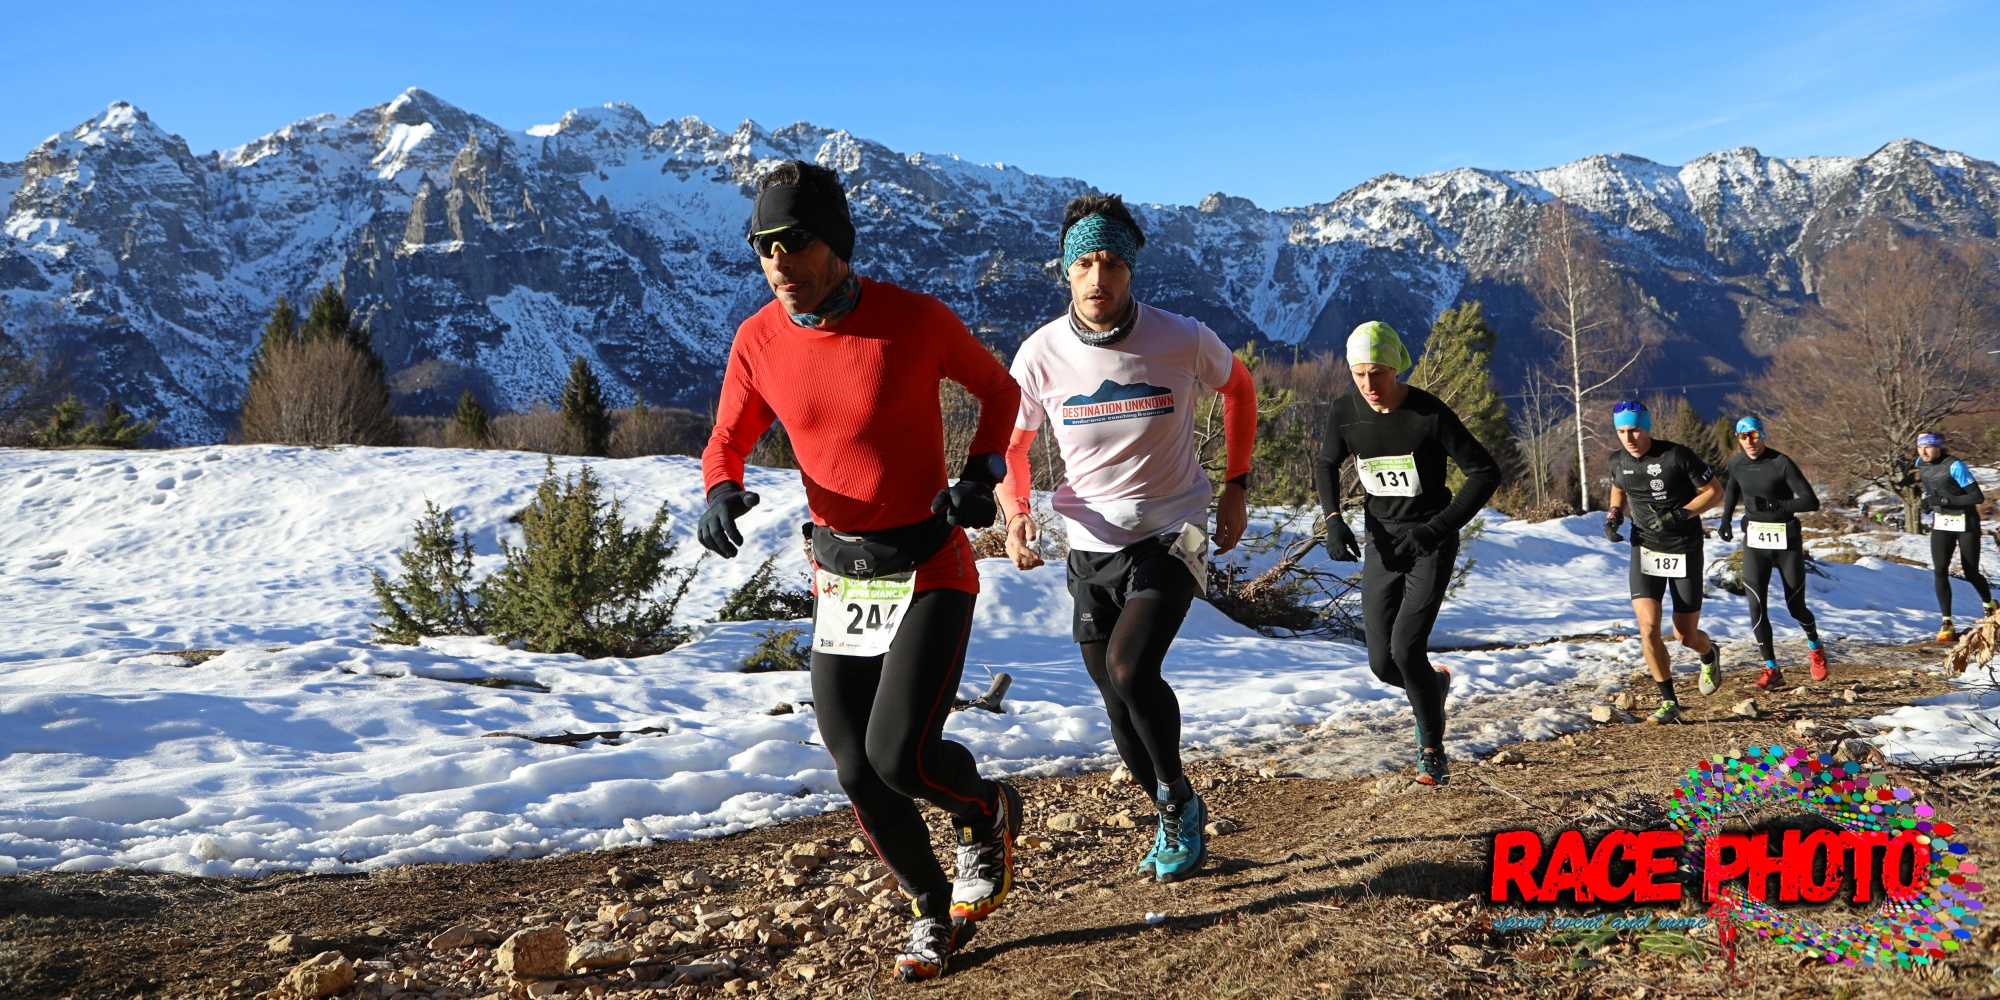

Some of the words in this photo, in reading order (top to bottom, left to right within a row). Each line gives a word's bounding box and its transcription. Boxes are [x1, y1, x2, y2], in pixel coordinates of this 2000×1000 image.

[1062, 402, 1122, 419] DESTINATION
[1125, 395, 1174, 412] UNKNOWN
[1375, 471, 1409, 487] 131
[1758, 532, 1780, 543] 411
[1654, 557, 1679, 570] 187
[871, 589, 904, 599] BIANCA
